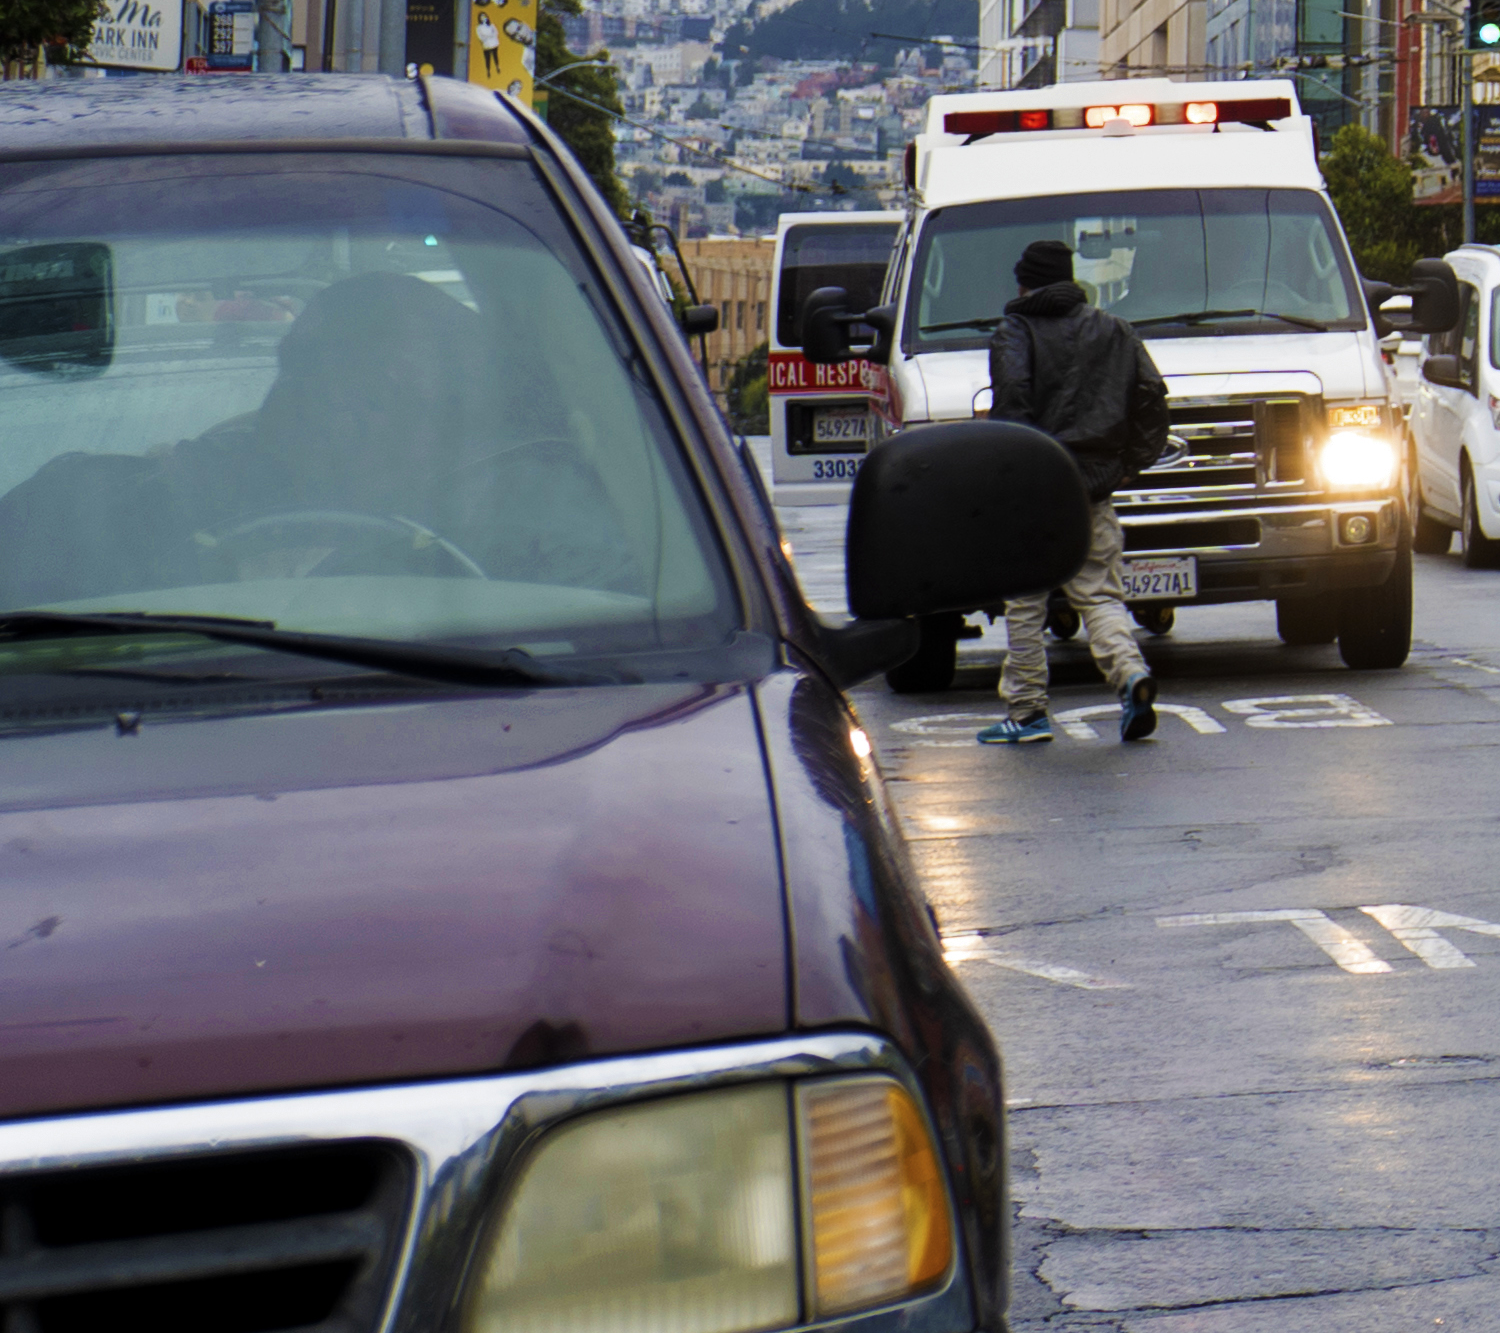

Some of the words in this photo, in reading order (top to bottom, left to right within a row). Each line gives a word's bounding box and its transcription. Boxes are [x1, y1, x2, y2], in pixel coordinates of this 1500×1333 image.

[131, 29, 159, 49] INN
[769, 360, 808, 387] ICAL
[813, 459, 864, 479] 3303
[1121, 571, 1192, 595] 54927A1
